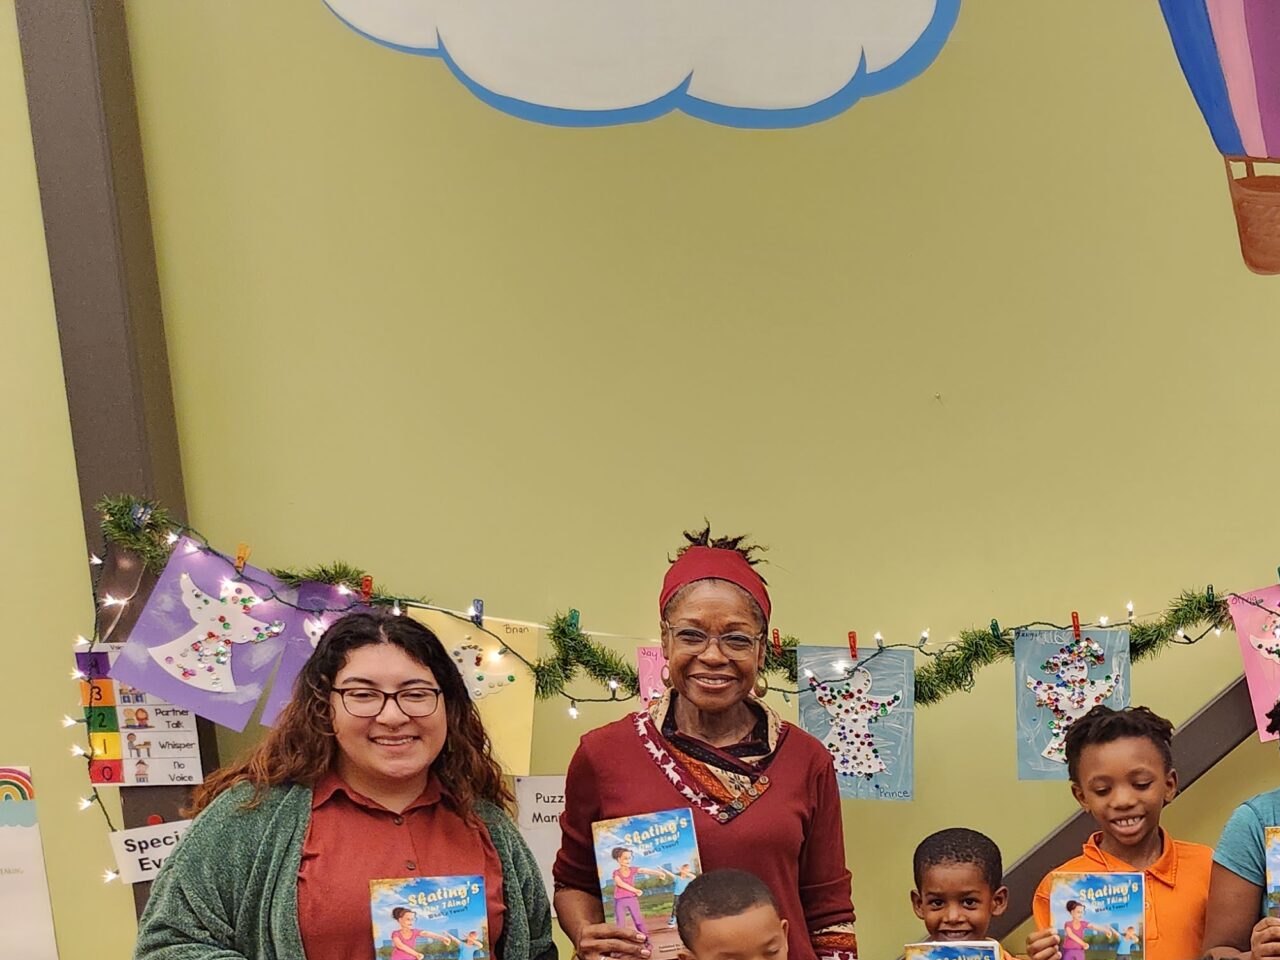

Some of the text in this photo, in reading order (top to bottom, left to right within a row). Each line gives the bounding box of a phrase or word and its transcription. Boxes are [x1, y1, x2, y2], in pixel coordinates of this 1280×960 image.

[91, 686, 102, 701] 3
[155, 708, 190, 716] Partner
[98, 713, 107, 728] 2
[165, 720, 184, 729] Talk
[158, 741, 196, 751] Whisper
[102, 766, 113, 781] 0
[168, 773, 194, 782] Voice
[535, 792, 565, 803] Puzz
[880, 786, 911, 798] Prince
[138, 857, 168, 871] Ev
[408, 881, 480, 906] Skating's
